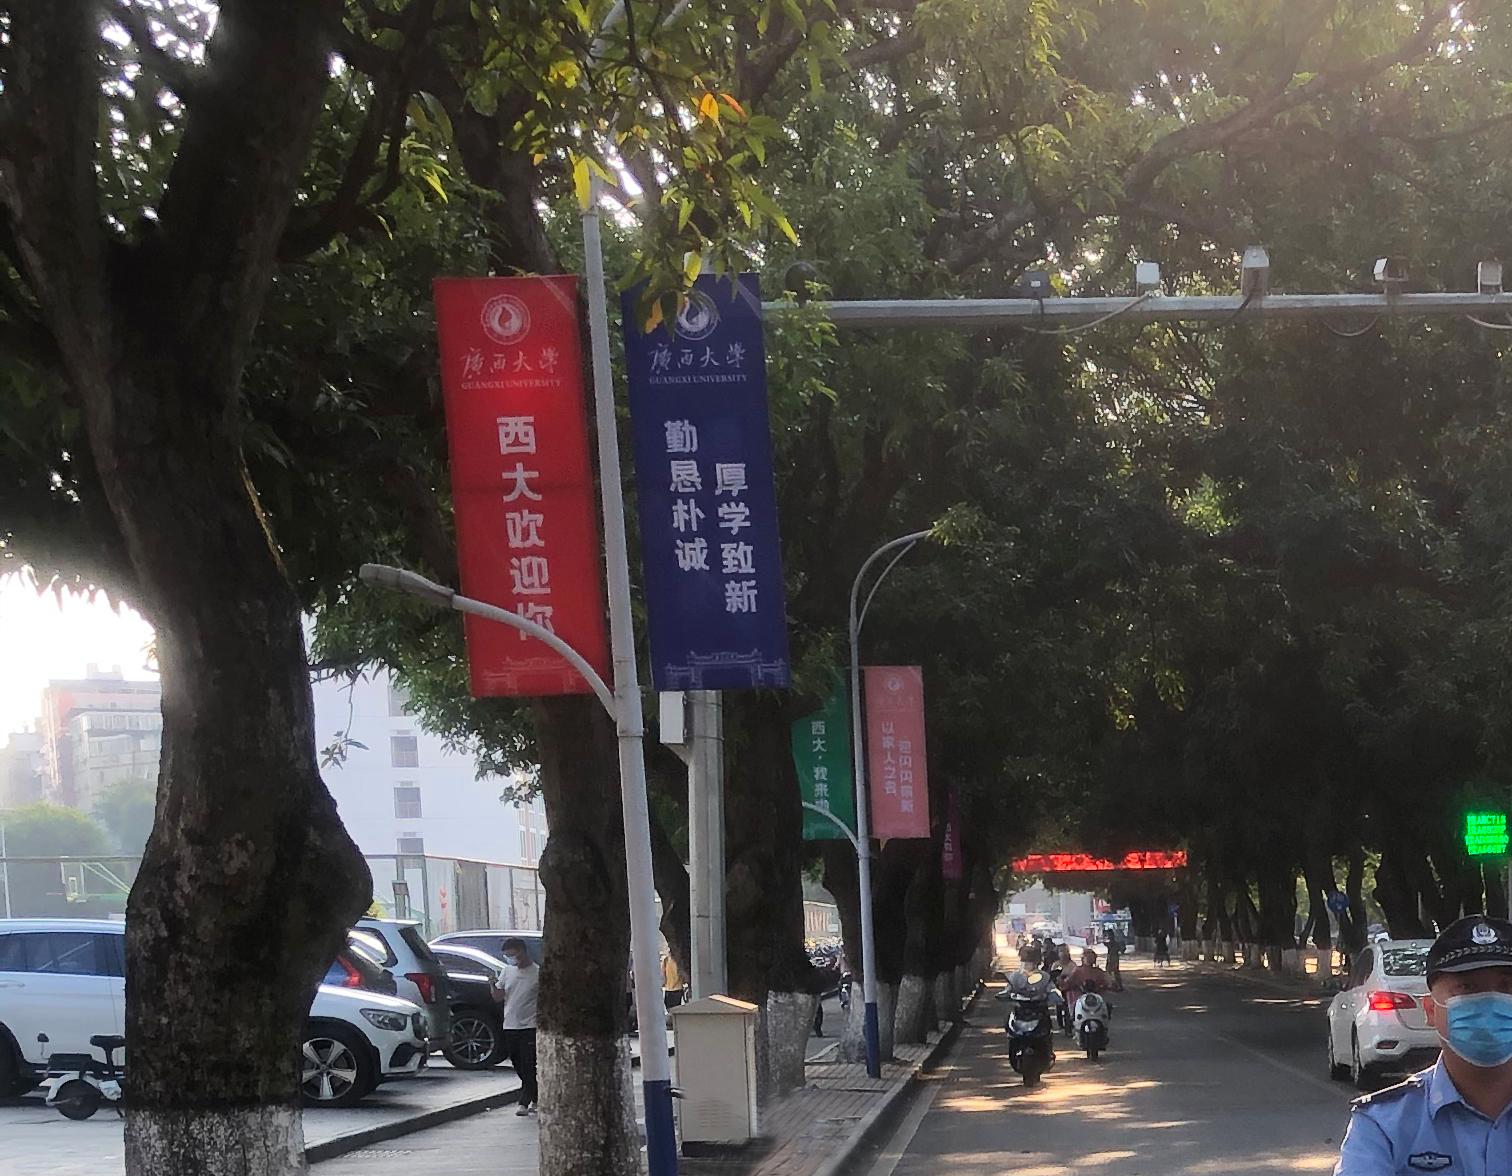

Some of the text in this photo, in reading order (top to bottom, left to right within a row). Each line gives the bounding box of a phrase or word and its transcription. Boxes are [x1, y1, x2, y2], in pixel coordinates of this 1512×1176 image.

[461, 379, 561, 390] GUANGXI UNIVERSITY
[649, 374, 748, 385] GUANGXI UNIVERSITY
[496, 415, 556, 641] 西大欢迎你
[663, 419, 711, 573] 勤恳朴诚
[714, 462, 758, 614] 厚学致新
